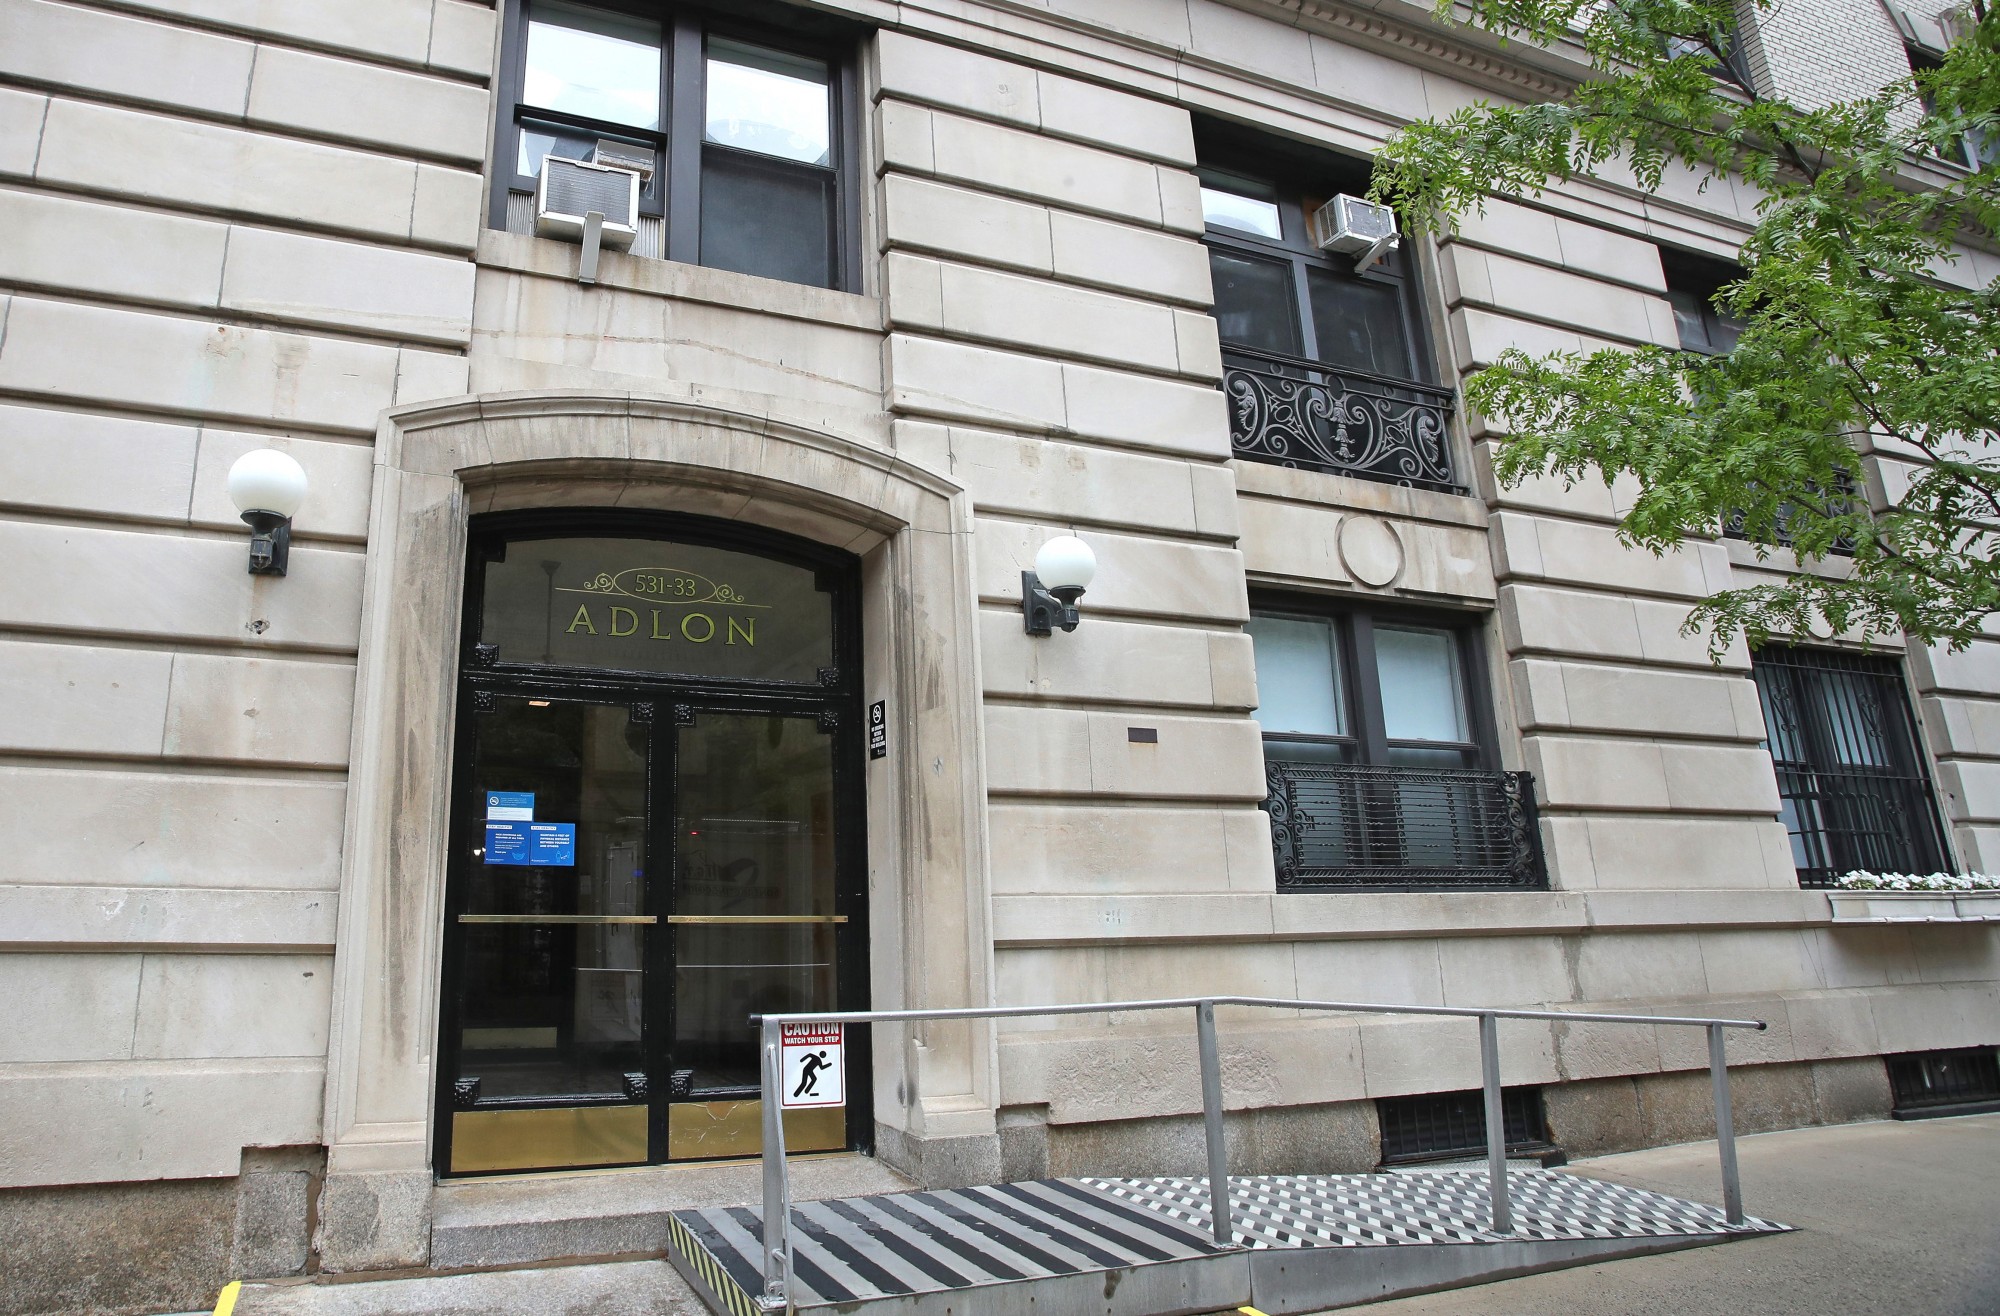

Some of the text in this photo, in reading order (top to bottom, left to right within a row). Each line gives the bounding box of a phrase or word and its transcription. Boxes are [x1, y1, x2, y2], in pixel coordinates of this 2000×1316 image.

[635, 574, 696, 597] 531-33
[565, 603, 756, 647] ADLON
[784, 1022, 839, 1036] CAUTION
